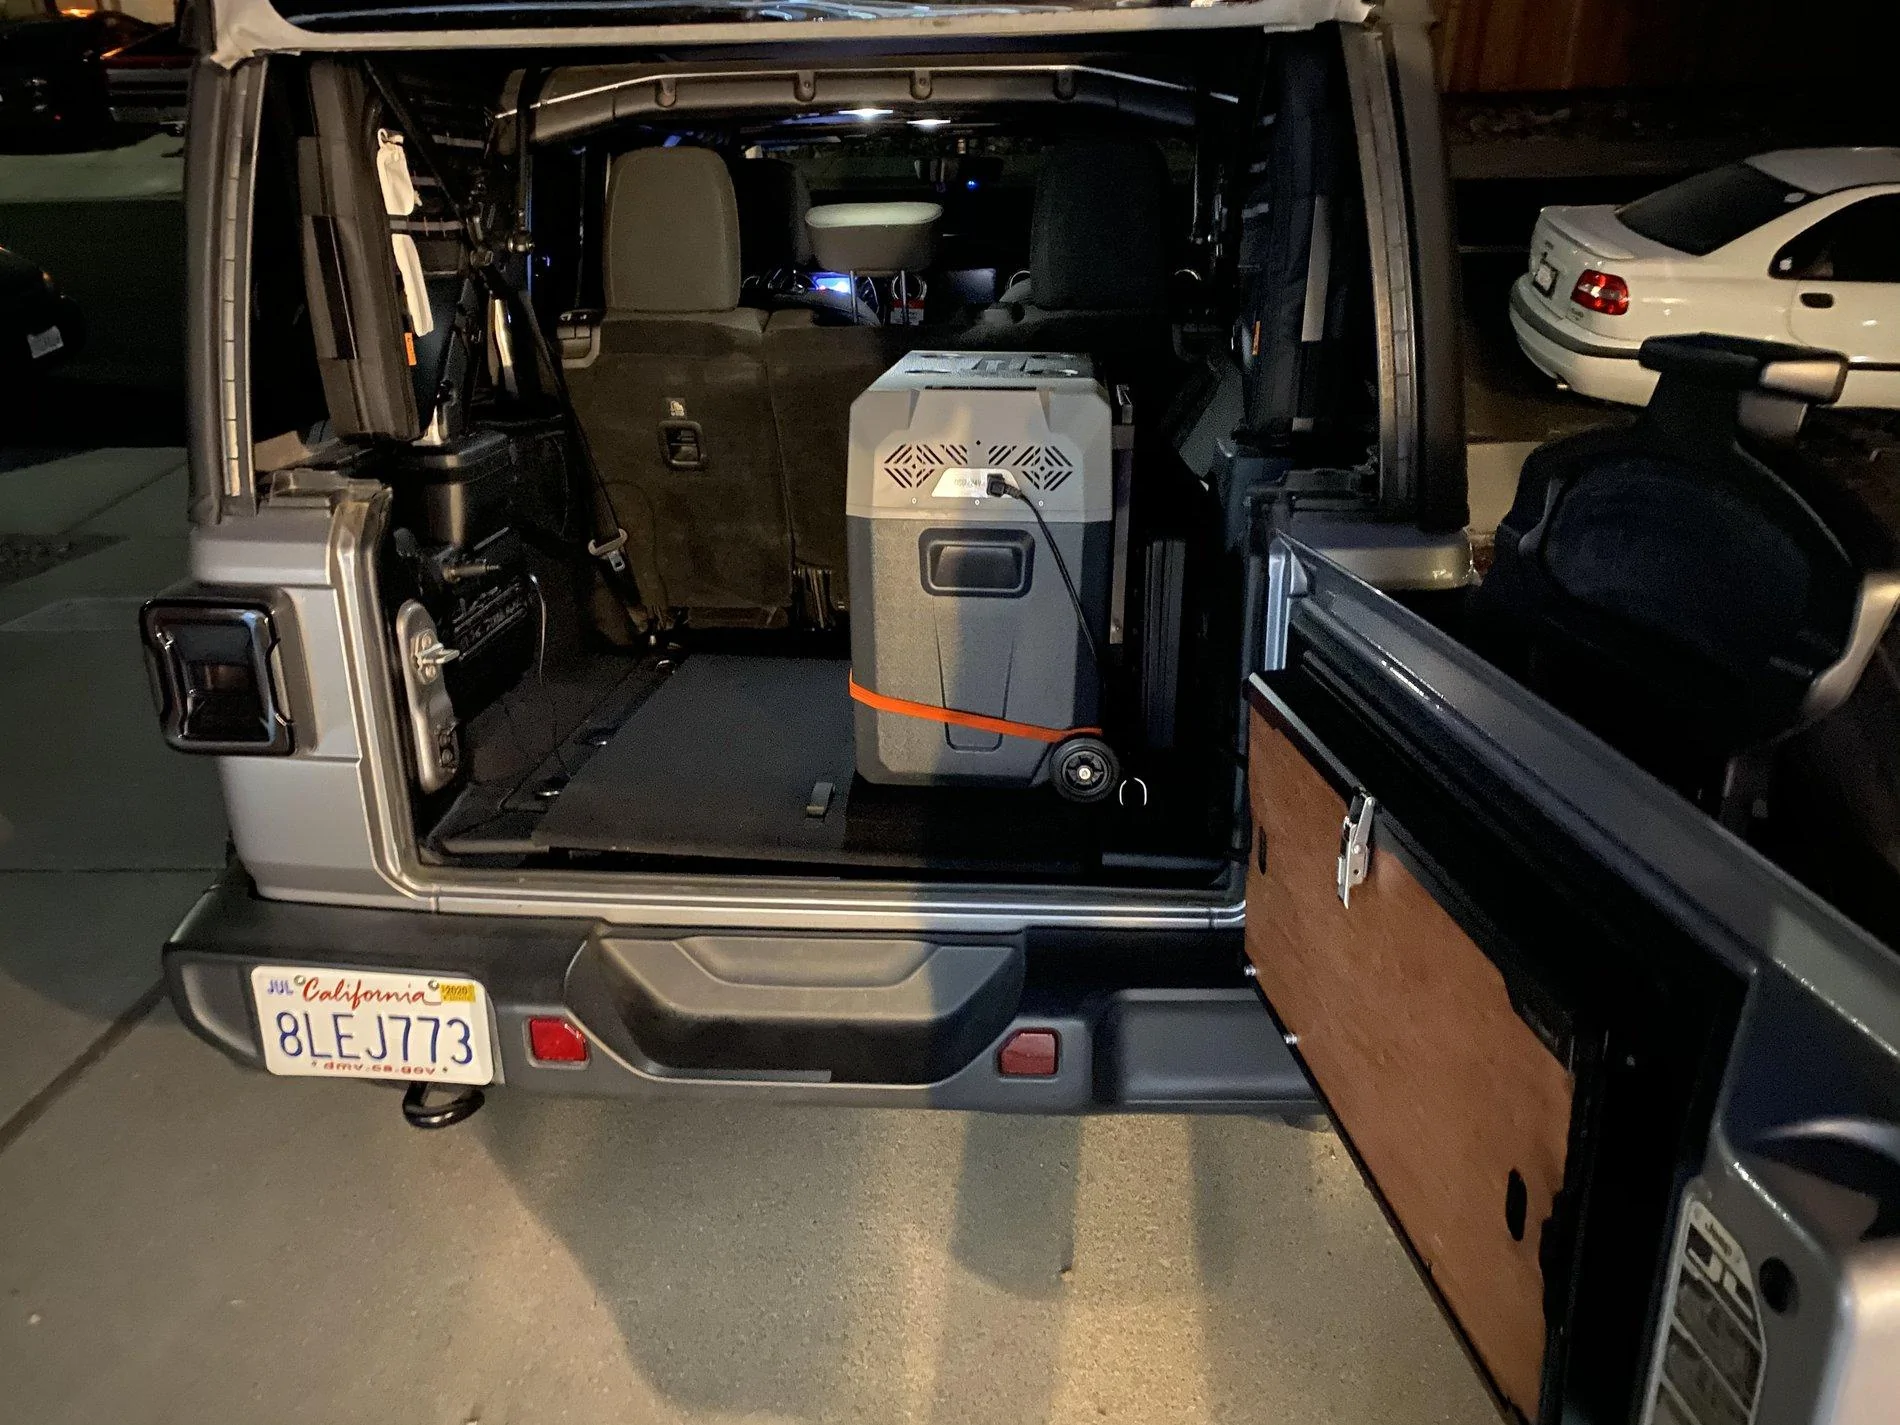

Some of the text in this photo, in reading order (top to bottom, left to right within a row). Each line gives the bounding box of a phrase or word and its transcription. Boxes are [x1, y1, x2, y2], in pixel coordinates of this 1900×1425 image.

[267, 979, 294, 995] JUL
[302, 976, 430, 1010] California
[276, 1011, 473, 1065] 8LEJ773
[323, 1061, 436, 1076] dmv.ca.gov
